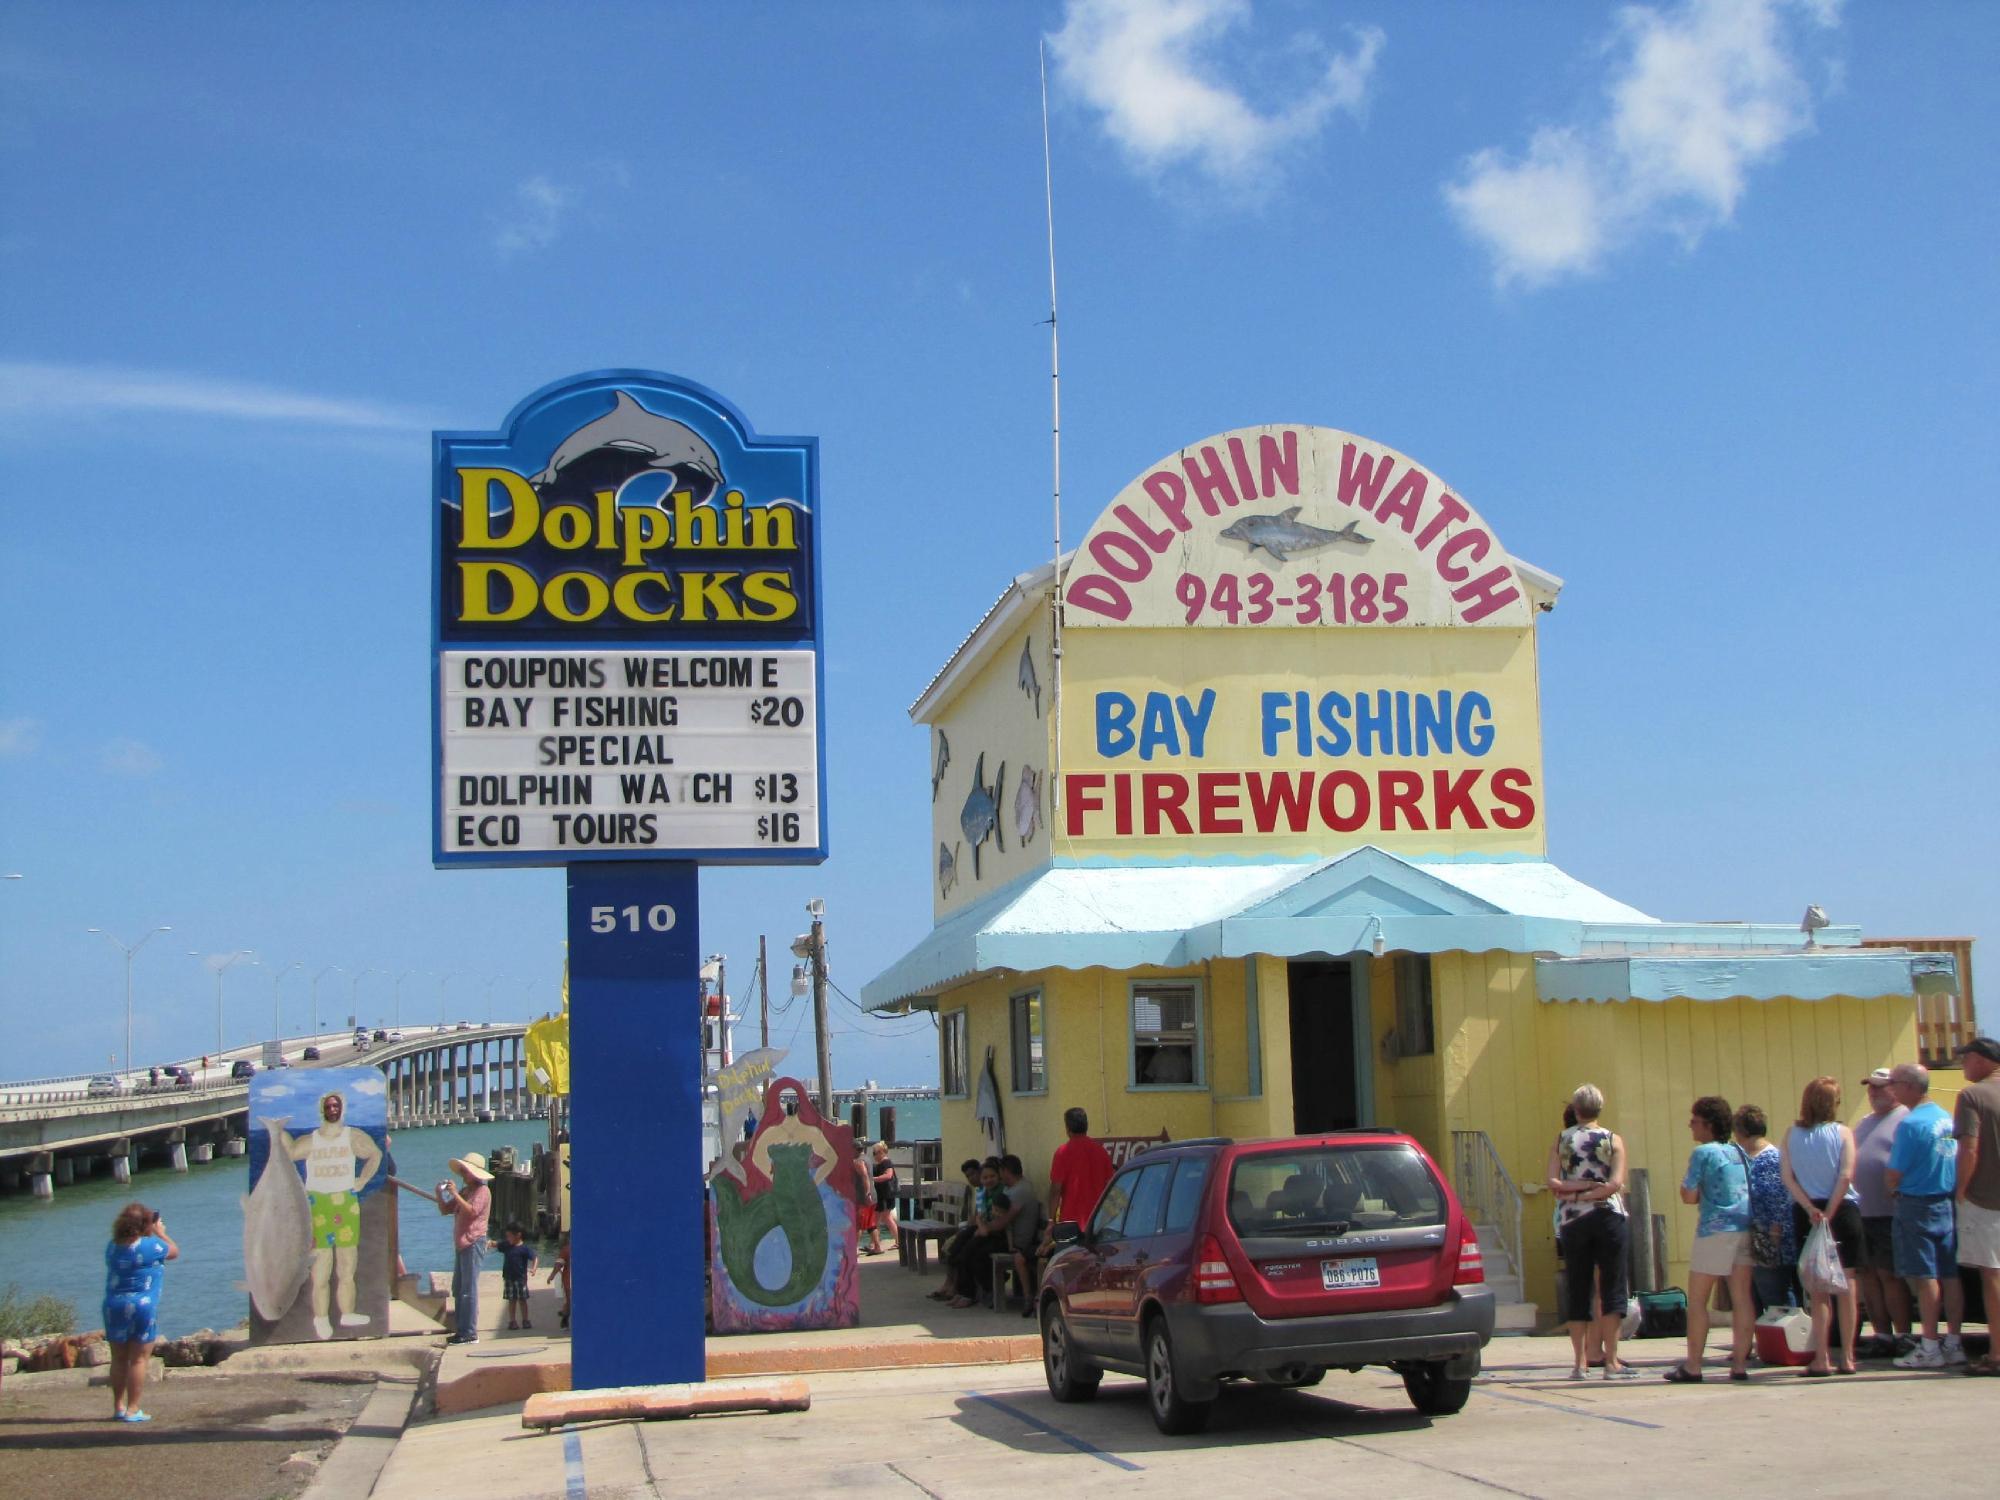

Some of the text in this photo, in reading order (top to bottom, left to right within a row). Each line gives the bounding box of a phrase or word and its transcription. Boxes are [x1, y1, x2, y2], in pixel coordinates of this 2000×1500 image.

[456, 467, 799, 567] Dolphin
[1066, 431, 1520, 624] DOLPHIN WATCH
[1175, 572, 1409, 625] 943-3185
[464, 657, 778, 688] COUPONS WELCOME
[465, 696, 804, 727] BAY FISHING $20
[1095, 688, 1495, 761] BAY FISHING
[539, 735, 674, 765] SPECIAL
[458, 774, 593, 806] DOLPHIN
[755, 773, 799, 804] $13
[1065, 767, 1536, 836] FIREWORKS
[458, 813, 800, 847] ECO TOURS $16
[590, 904, 676, 933] 510
[1306, 1235, 1389, 1247] SUBARU
